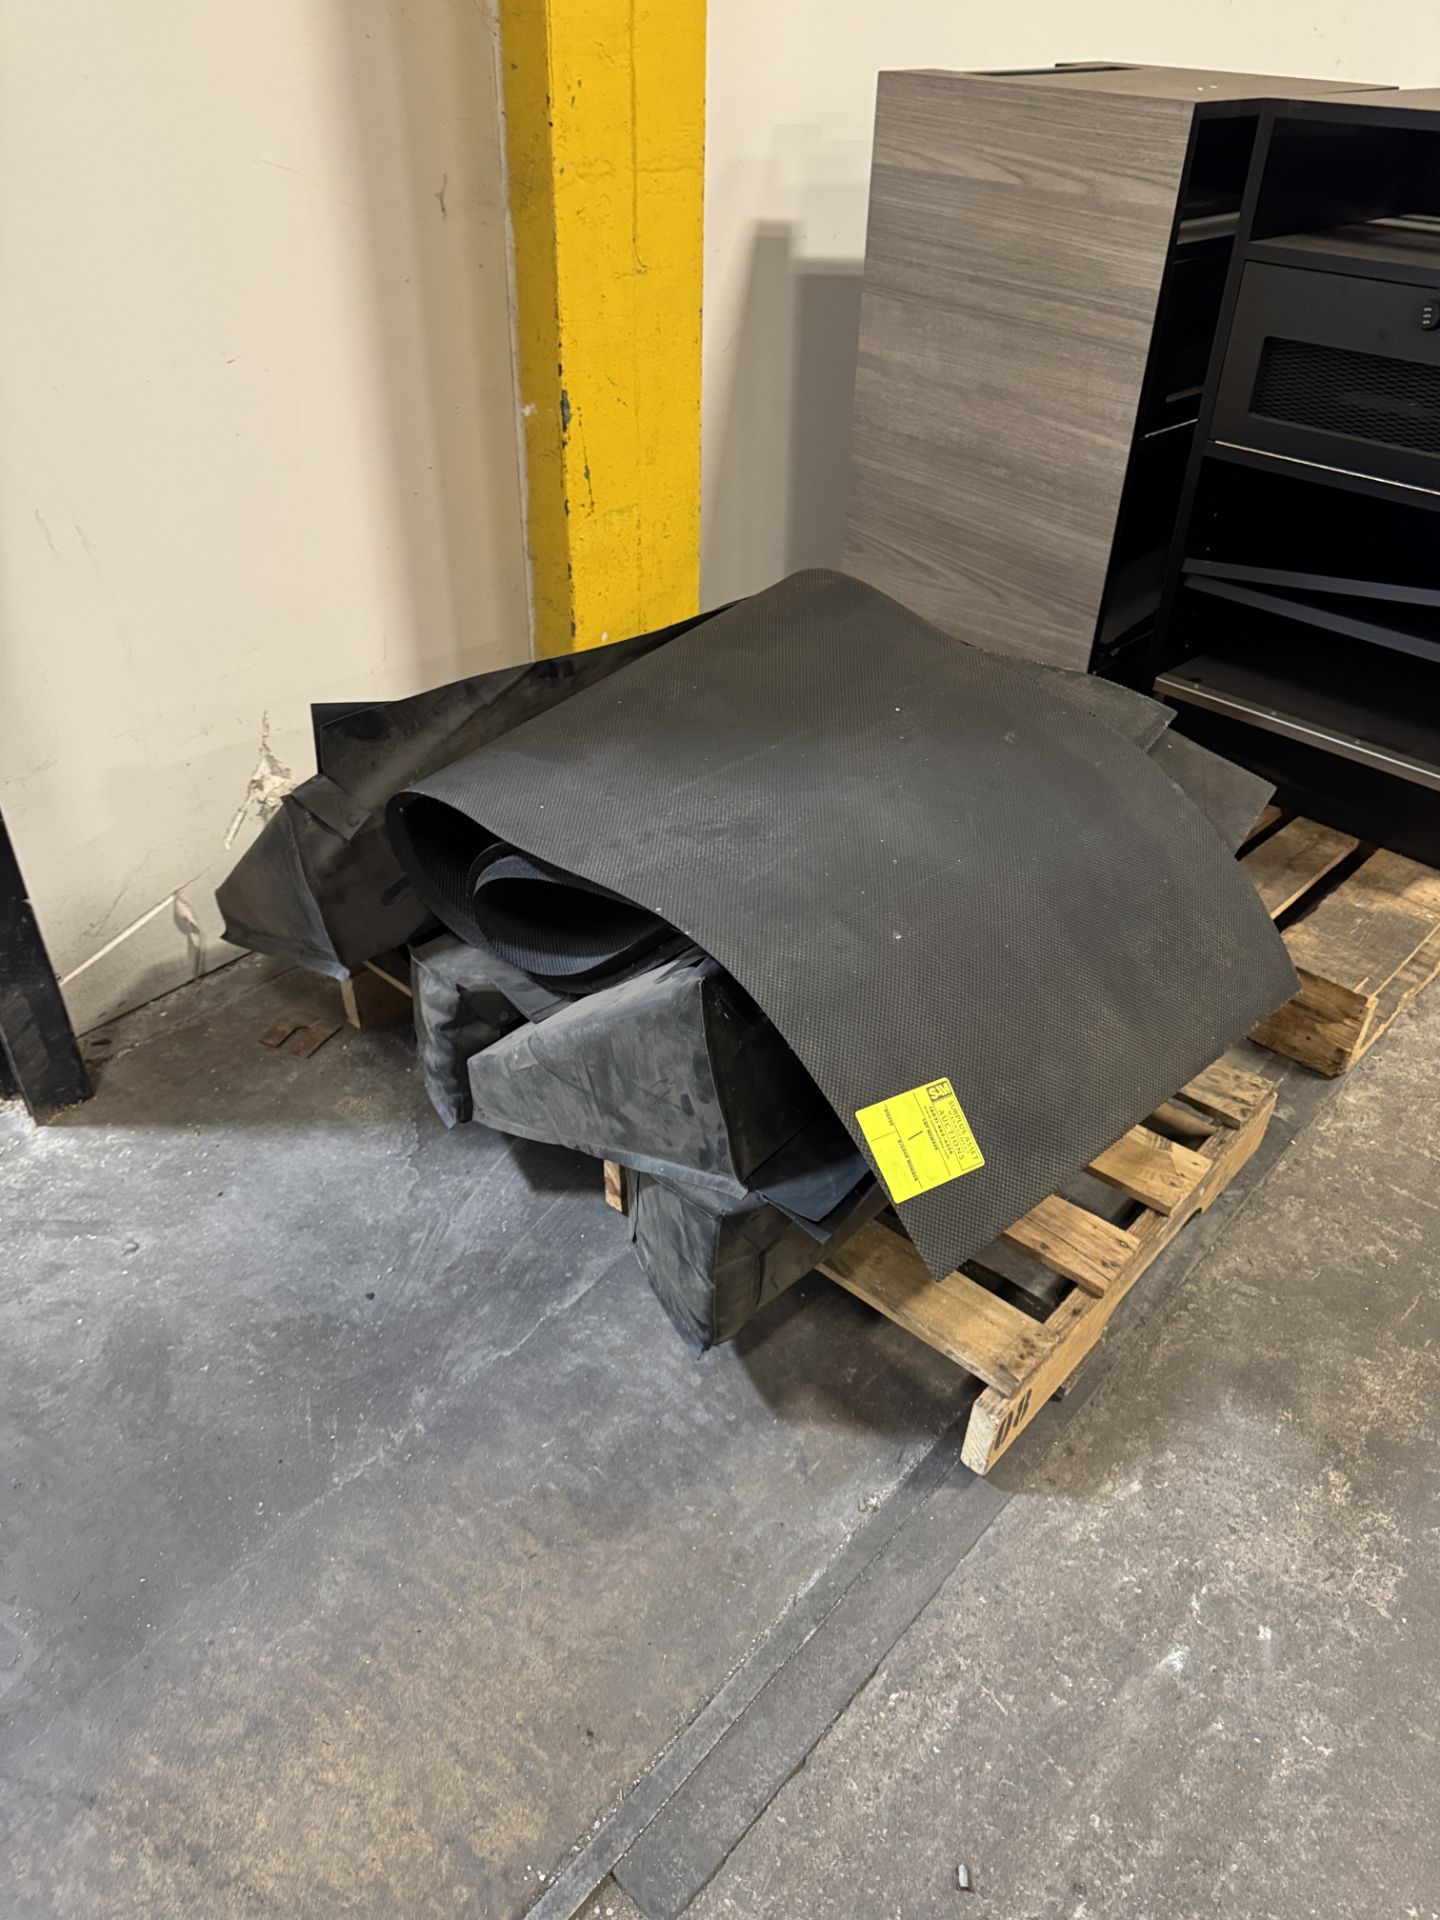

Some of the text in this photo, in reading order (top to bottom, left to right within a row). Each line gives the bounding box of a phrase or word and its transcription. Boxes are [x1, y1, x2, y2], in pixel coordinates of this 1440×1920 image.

[928, 1082, 951, 1101] SAM
[938, 1109, 964, 1160] AUCTIONS
[948, 1100, 979, 1160] SURPLUS ASSET
